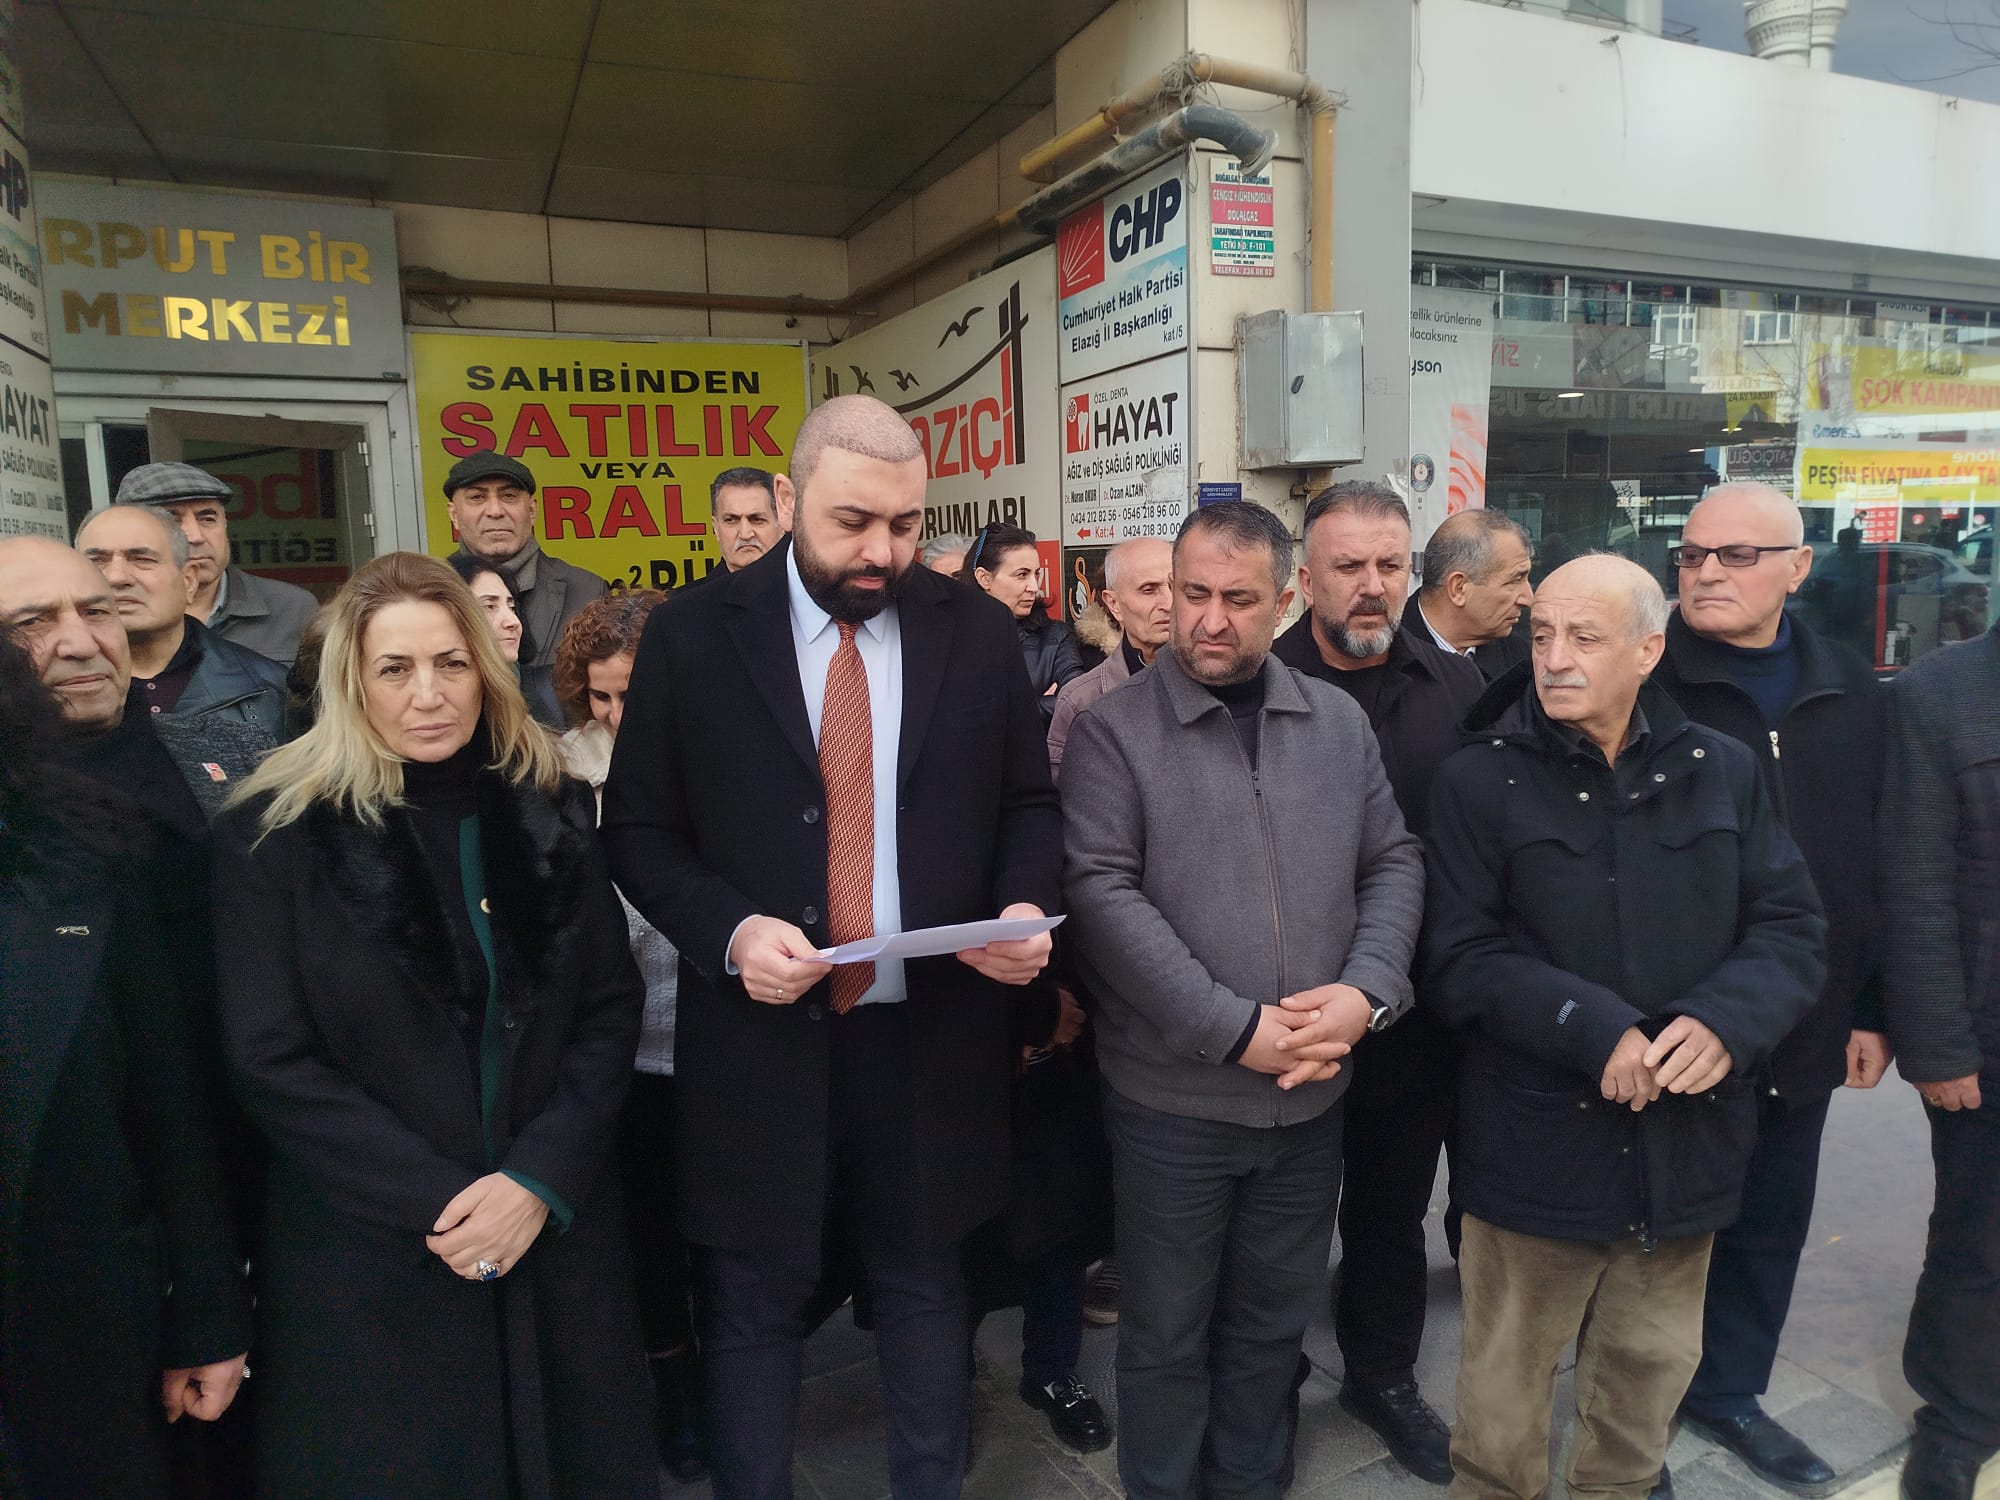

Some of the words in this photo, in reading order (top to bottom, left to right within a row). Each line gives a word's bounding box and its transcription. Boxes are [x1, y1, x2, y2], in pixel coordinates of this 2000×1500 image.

[1109, 177, 1182, 263] CHP
[44, 218, 237, 276] RPUT
[259, 231, 371, 285] BİR
[1063, 295, 1116, 331] Cumhuriyet
[1119, 283, 1143, 309] Halk
[1146, 266, 1183, 299] Partisi
[62, 289, 352, 347] MERKEZİ
[1072, 329, 1101, 353] Elazığ
[1103, 322, 1111, 342] İl
[1113, 303, 1173, 338] Başkanlığı
[1434, 311, 1482, 326] ürünlerine
[1410, 327, 1458, 343] lacaksınız
[466, 360, 760, 395] SAHİBİNDEN
[1860, 377, 1905, 409] ŞOK
[1910, 381, 2000, 409] KAMPAN
[1094, 392, 1108, 404] ÖZEL
[1110, 387, 1129, 402] DENTA
[440, 402, 784, 459] SATILIK
[1094, 392, 1178, 450] HAYAT
[580, 462, 676, 480] VEYA
[1067, 461, 1082, 480] AĞIZ
[1083, 466, 1091, 478] ve
[1092, 457, 1104, 479] DİŞ
[1105, 452, 1133, 475] SAĞLIĞI
[1135, 443, 1182, 471] POLİKLİNİĞİ
[1808, 462, 1857, 489] PEŞİN
[1109, 487, 1124, 500] Ozan
[1125, 483, 1144, 499] ALTAN
[1070, 512, 1086, 524] 0424
[1087, 511, 1097, 523] 212
[1099, 510, 1107, 522] 82
[1108, 510, 1117, 521] 56
[1123, 507, 1141, 520] 0546
[1143, 506, 1155, 519] 218
[1156, 505, 1167, 517] 96
[1169, 503, 1180, 517] 00
[1095, 525, 1114, 539] Kat:4
[1123, 526, 1141, 537] 0424
[1143, 524, 1155, 536] 218
[1157, 523, 1168, 536] 30
[1170, 523, 1181, 535] 00
